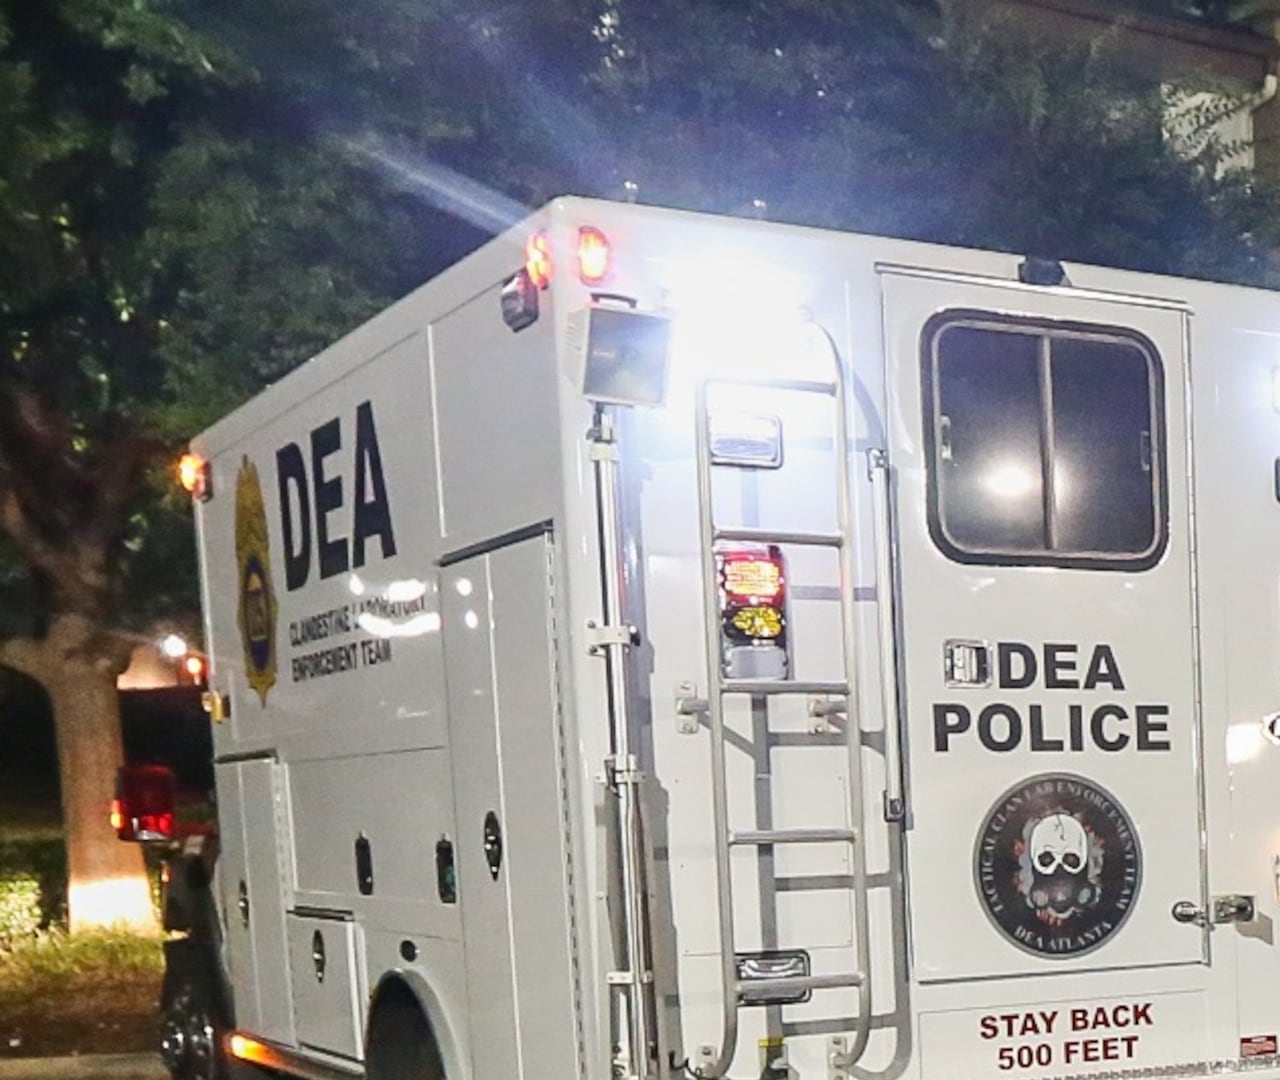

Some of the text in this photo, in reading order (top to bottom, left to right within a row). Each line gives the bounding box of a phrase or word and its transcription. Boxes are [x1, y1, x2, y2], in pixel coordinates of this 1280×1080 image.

[276, 399, 397, 591] DEA
[292, 639, 392, 682] ENFORCEMENT TEAM
[997, 642, 1125, 690] DEA
[933, 703, 1172, 753] POLICE
[1014, 921, 1112, 950] DEA ATLANTA
[979, 1003, 1154, 1040] STAY BACK
[998, 1036, 1139, 1071] 500 FEET
